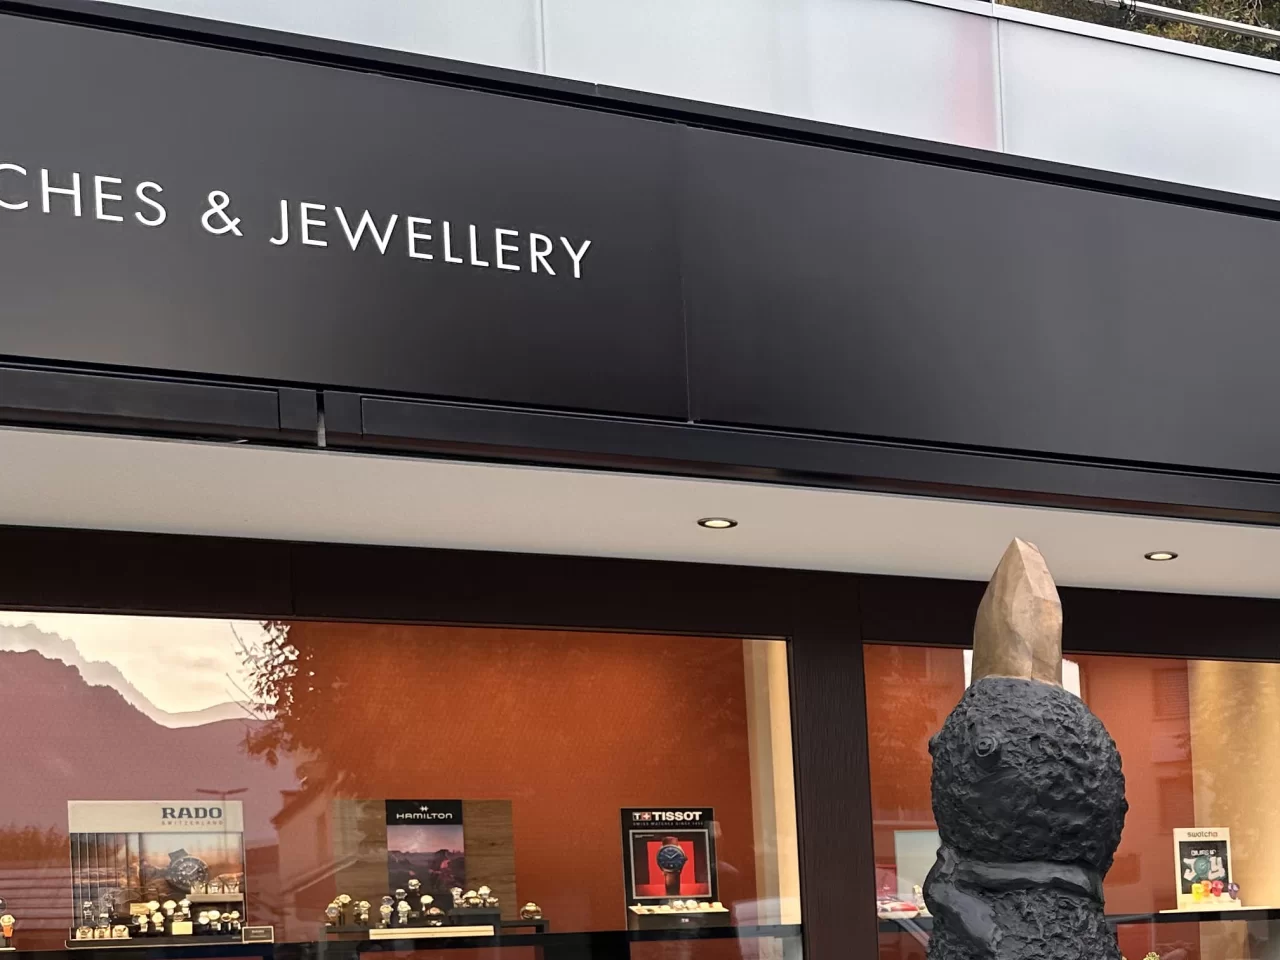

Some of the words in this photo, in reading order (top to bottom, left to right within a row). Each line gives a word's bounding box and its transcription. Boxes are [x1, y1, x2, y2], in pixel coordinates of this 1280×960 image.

[200, 189, 244, 238] &
[269, 198, 593, 280] JEWELLERY
[161, 806, 223, 819] RADO
[396, 812, 454, 820] HAMILTON
[652, 811, 703, 821] TISSOT
